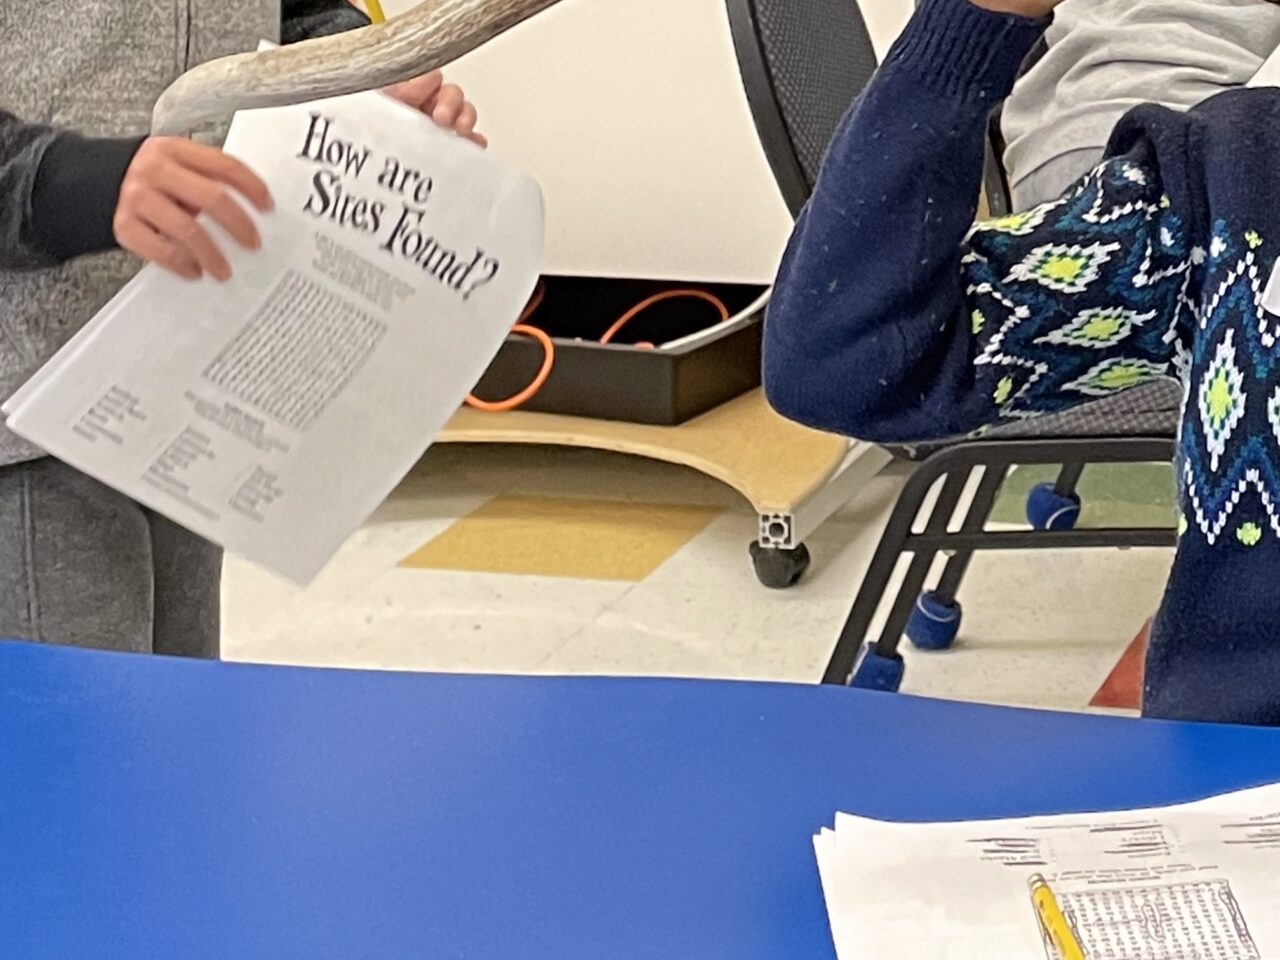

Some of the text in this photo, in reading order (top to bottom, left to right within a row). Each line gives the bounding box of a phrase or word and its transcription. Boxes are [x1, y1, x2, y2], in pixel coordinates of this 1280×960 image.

[297, 111, 434, 204] How are
[303, 168, 385, 234] Sites
[380, 201, 500, 302] Found?
